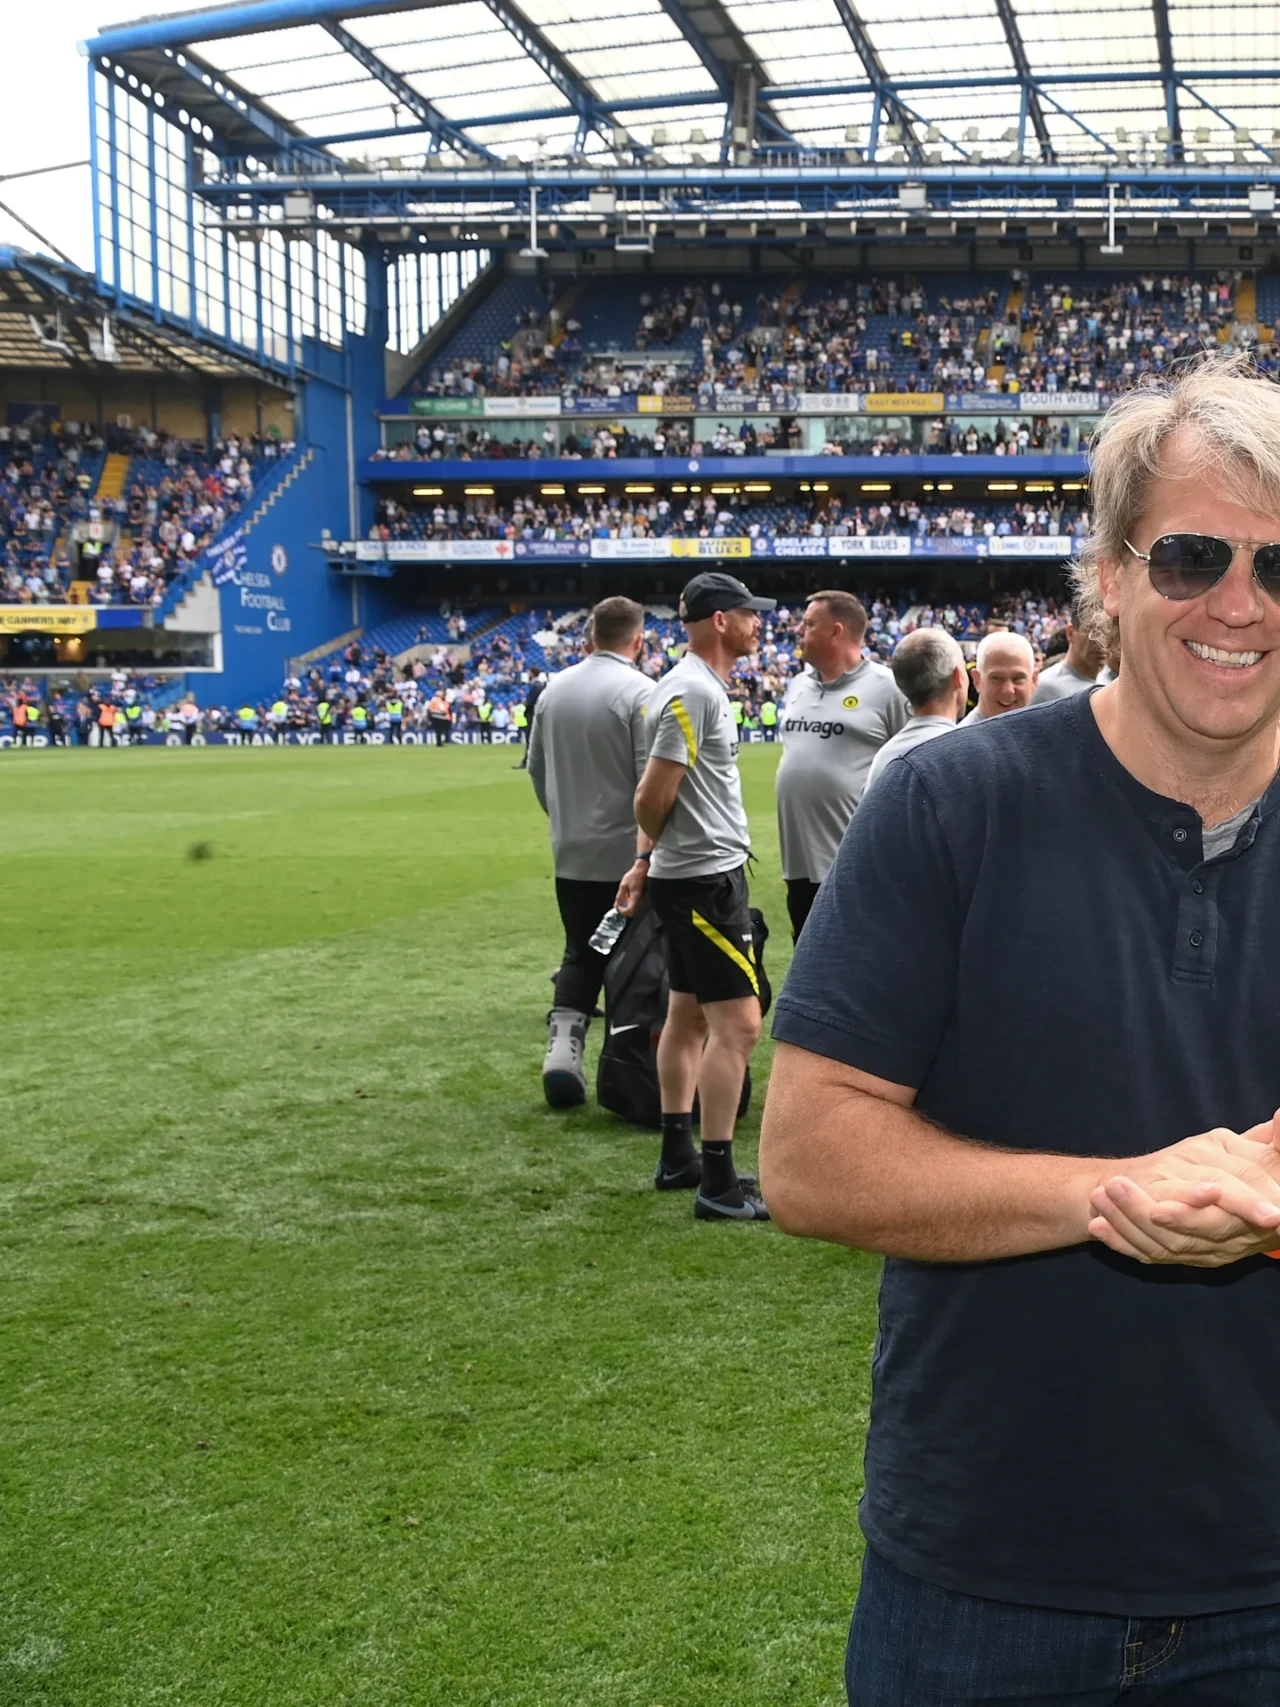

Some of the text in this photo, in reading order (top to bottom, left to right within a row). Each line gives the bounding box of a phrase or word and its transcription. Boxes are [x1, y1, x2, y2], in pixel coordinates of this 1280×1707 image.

[1022, 392, 1062, 404] SOUTH
[1066, 392, 1099, 404] WEST
[716, 404, 744, 412] BLUES
[773, 538, 827, 547] ADELAIDE
[841, 540, 898, 550] YORK BLUES
[775, 547, 826, 556] CHELSEA
[232, 569, 271, 588] CHELSEA
[240, 586, 286, 612] FOOTBALL
[56, 616, 76, 624] WAY
[266, 611, 291, 632] CLUB
[785, 716, 844, 739] trivago
